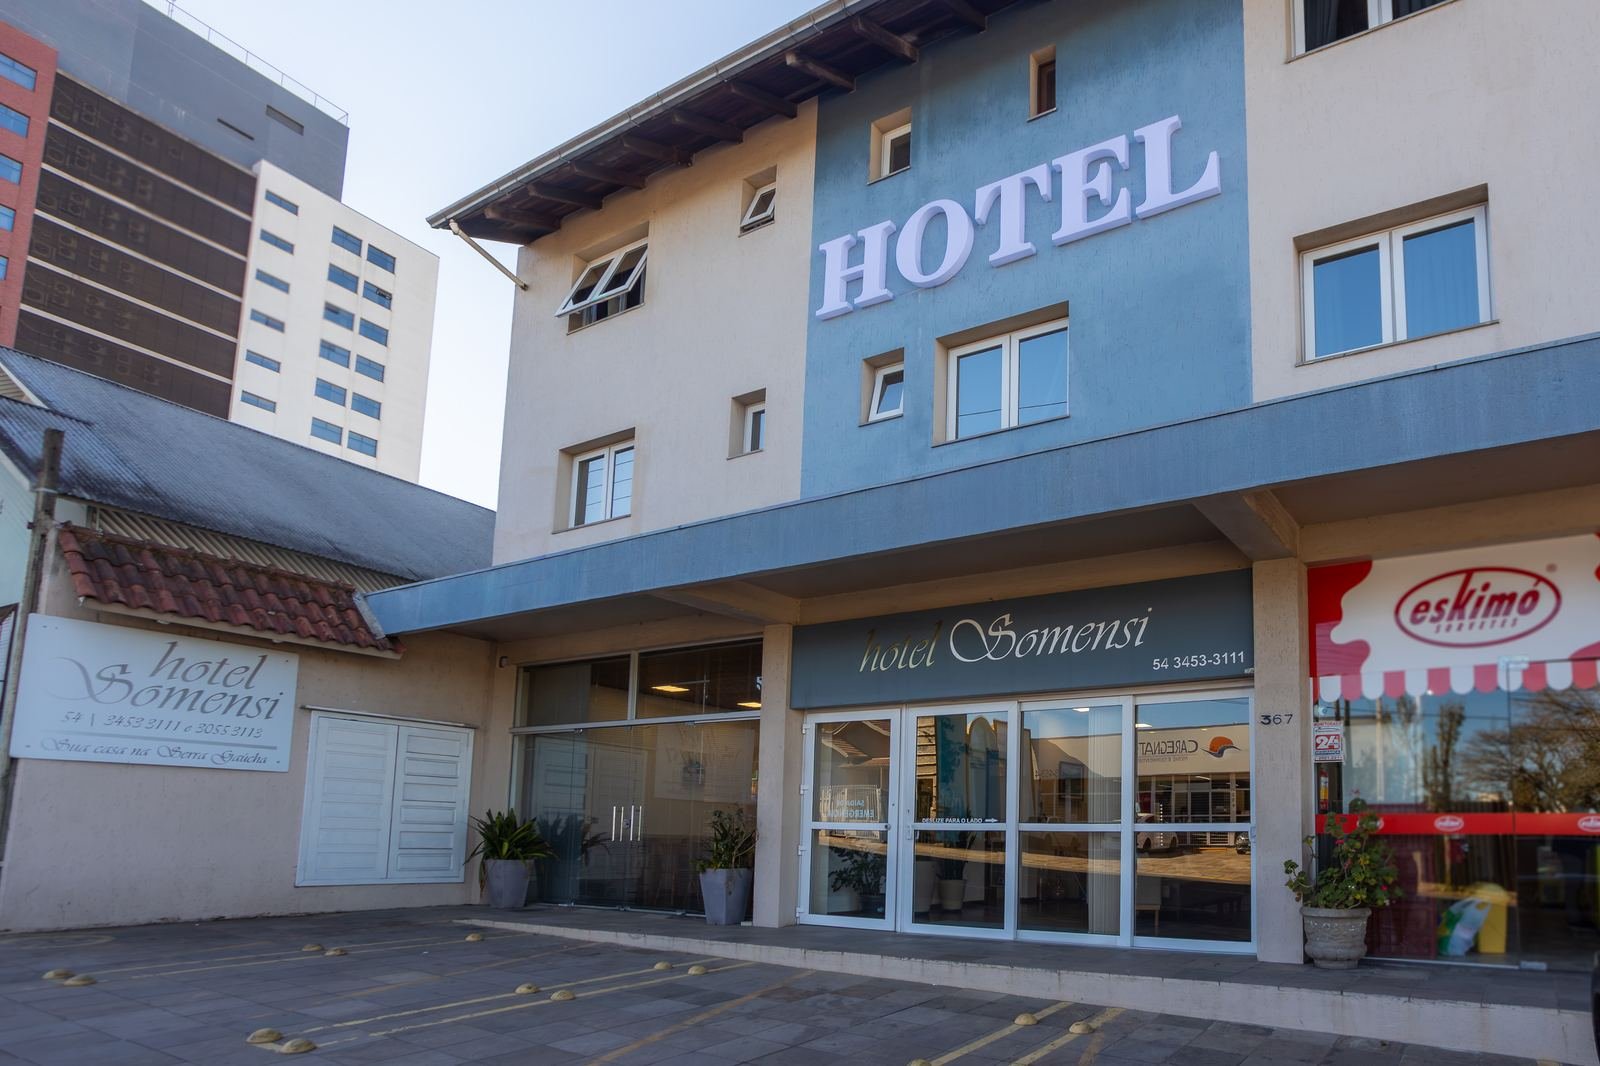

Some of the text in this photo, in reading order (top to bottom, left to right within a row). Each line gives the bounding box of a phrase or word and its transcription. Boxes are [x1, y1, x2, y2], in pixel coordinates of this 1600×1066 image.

[816, 114, 1221, 321] HOTEL
[858, 607, 1152, 673] hotel Somensi
[149, 640, 268, 690] hotel
[1152, 651, 1244, 670] 54 3453-3111
[47, 656, 284, 720] Somensi
[61, 711, 82, 723] 54
[1260, 713, 1293, 726] 367
[40, 737, 90, 753] Sua
[93, 745, 128, 756] casa
[130, 747, 152, 757] na
[157, 745, 208, 760] Serra
[1316, 735, 1339, 749] 24
